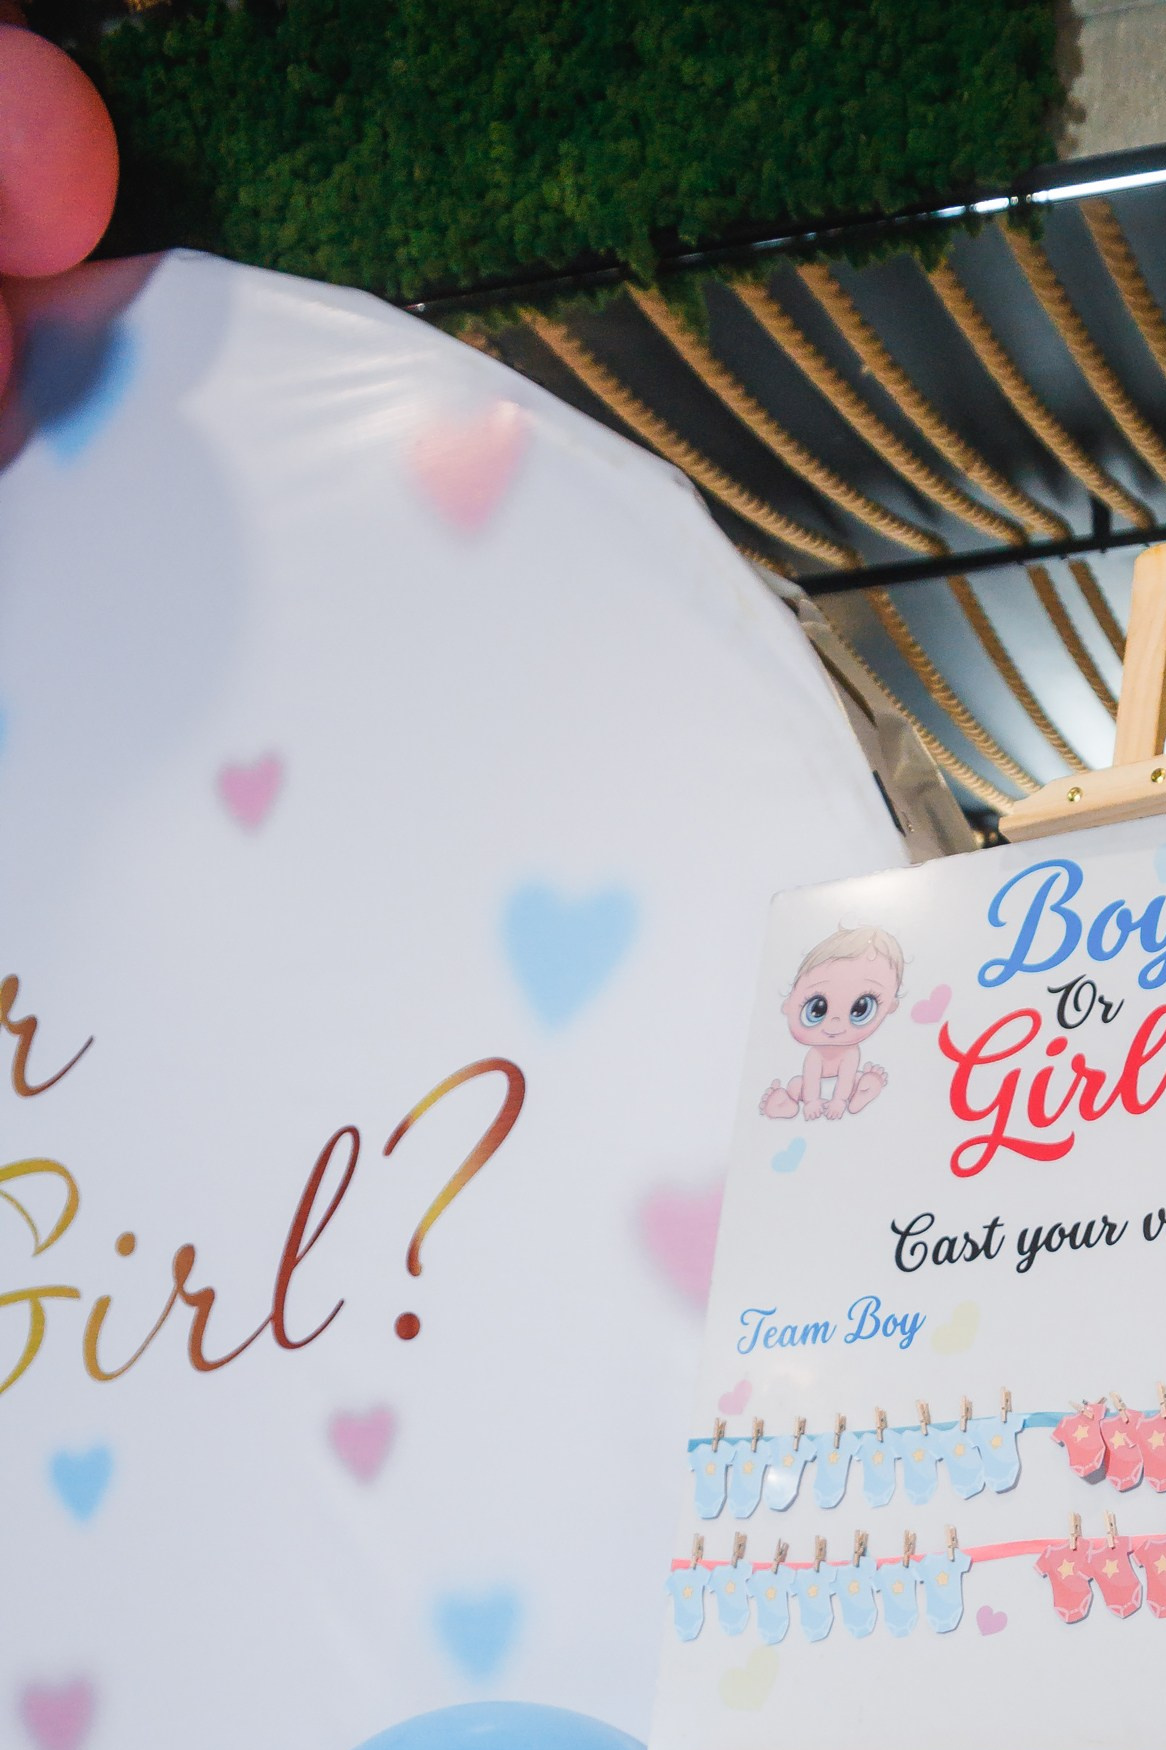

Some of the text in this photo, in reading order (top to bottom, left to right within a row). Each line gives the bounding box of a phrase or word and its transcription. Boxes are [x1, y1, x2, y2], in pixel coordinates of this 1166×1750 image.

[1046, 973, 1125, 1030] Or
[0, 974, 95, 1098] r
[890, 1211, 1006, 1274] Cast
[1015, 1214, 1130, 1275] your
[736, 1294, 927, 1355] Team Boy
